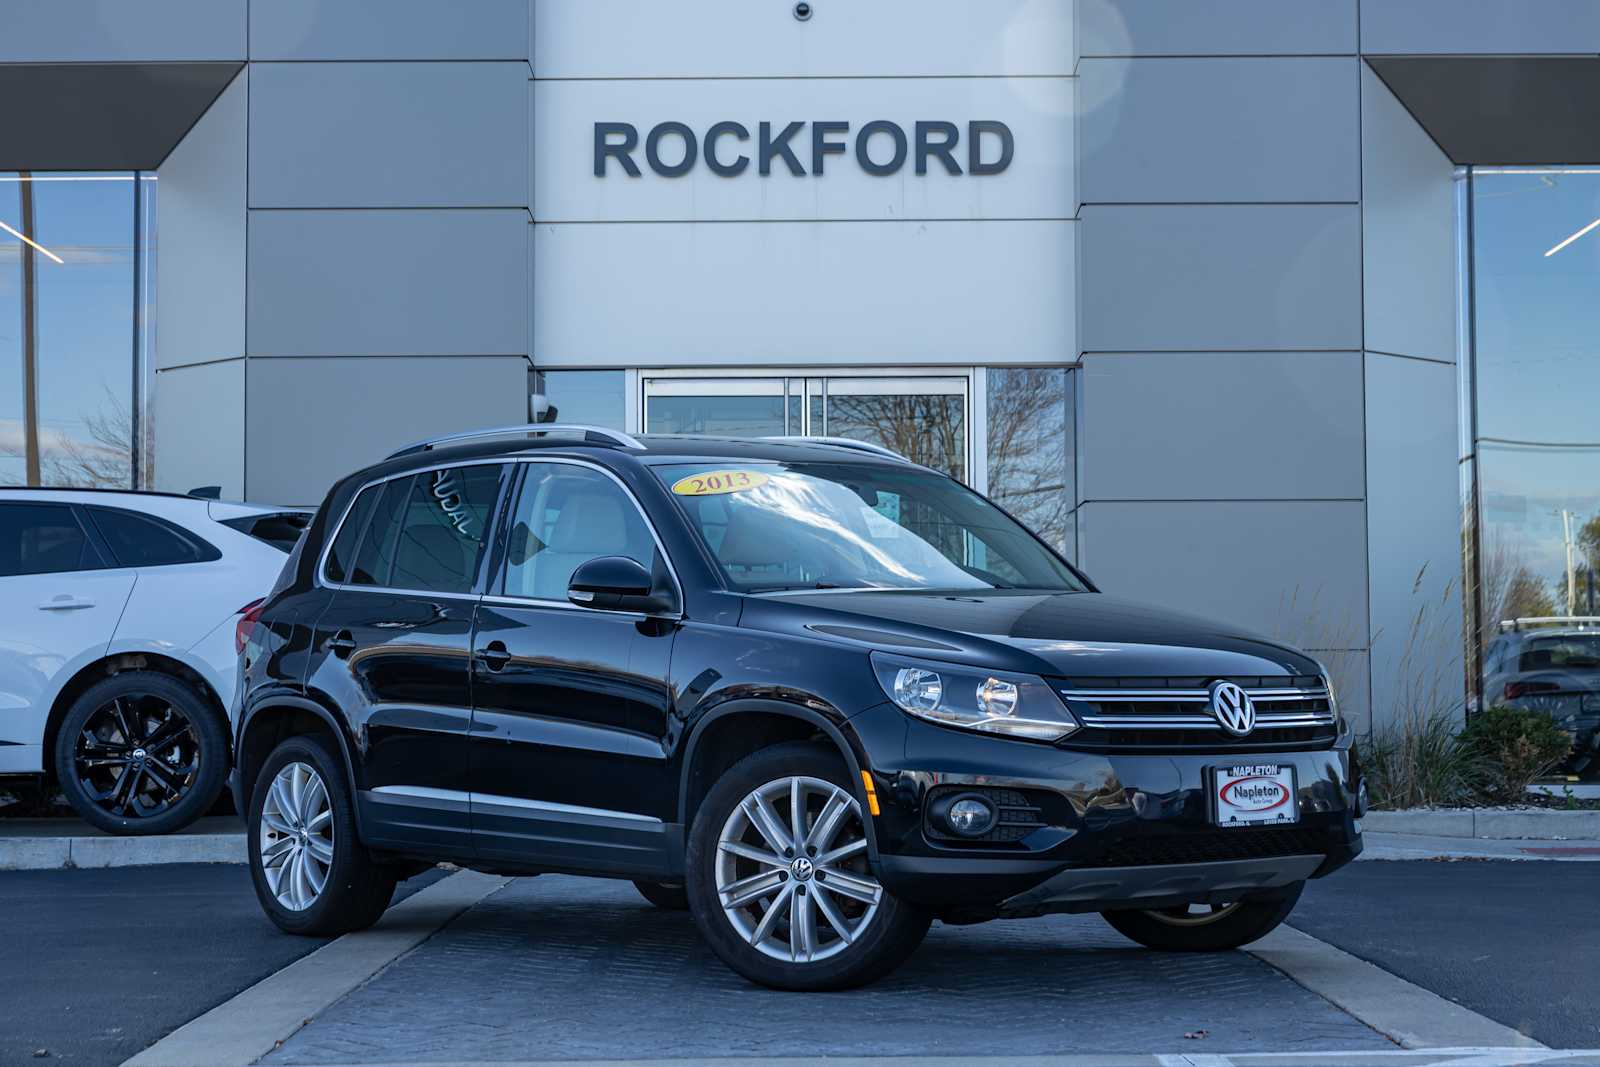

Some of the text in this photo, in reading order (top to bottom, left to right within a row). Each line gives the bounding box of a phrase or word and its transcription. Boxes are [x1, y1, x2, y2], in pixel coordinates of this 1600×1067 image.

[594, 120, 1015, 177] ROCKFORD
[691, 472, 751, 493] 2013
[1233, 765, 1278, 776] NAPLETON
[1234, 785, 1279, 800] Napleton
